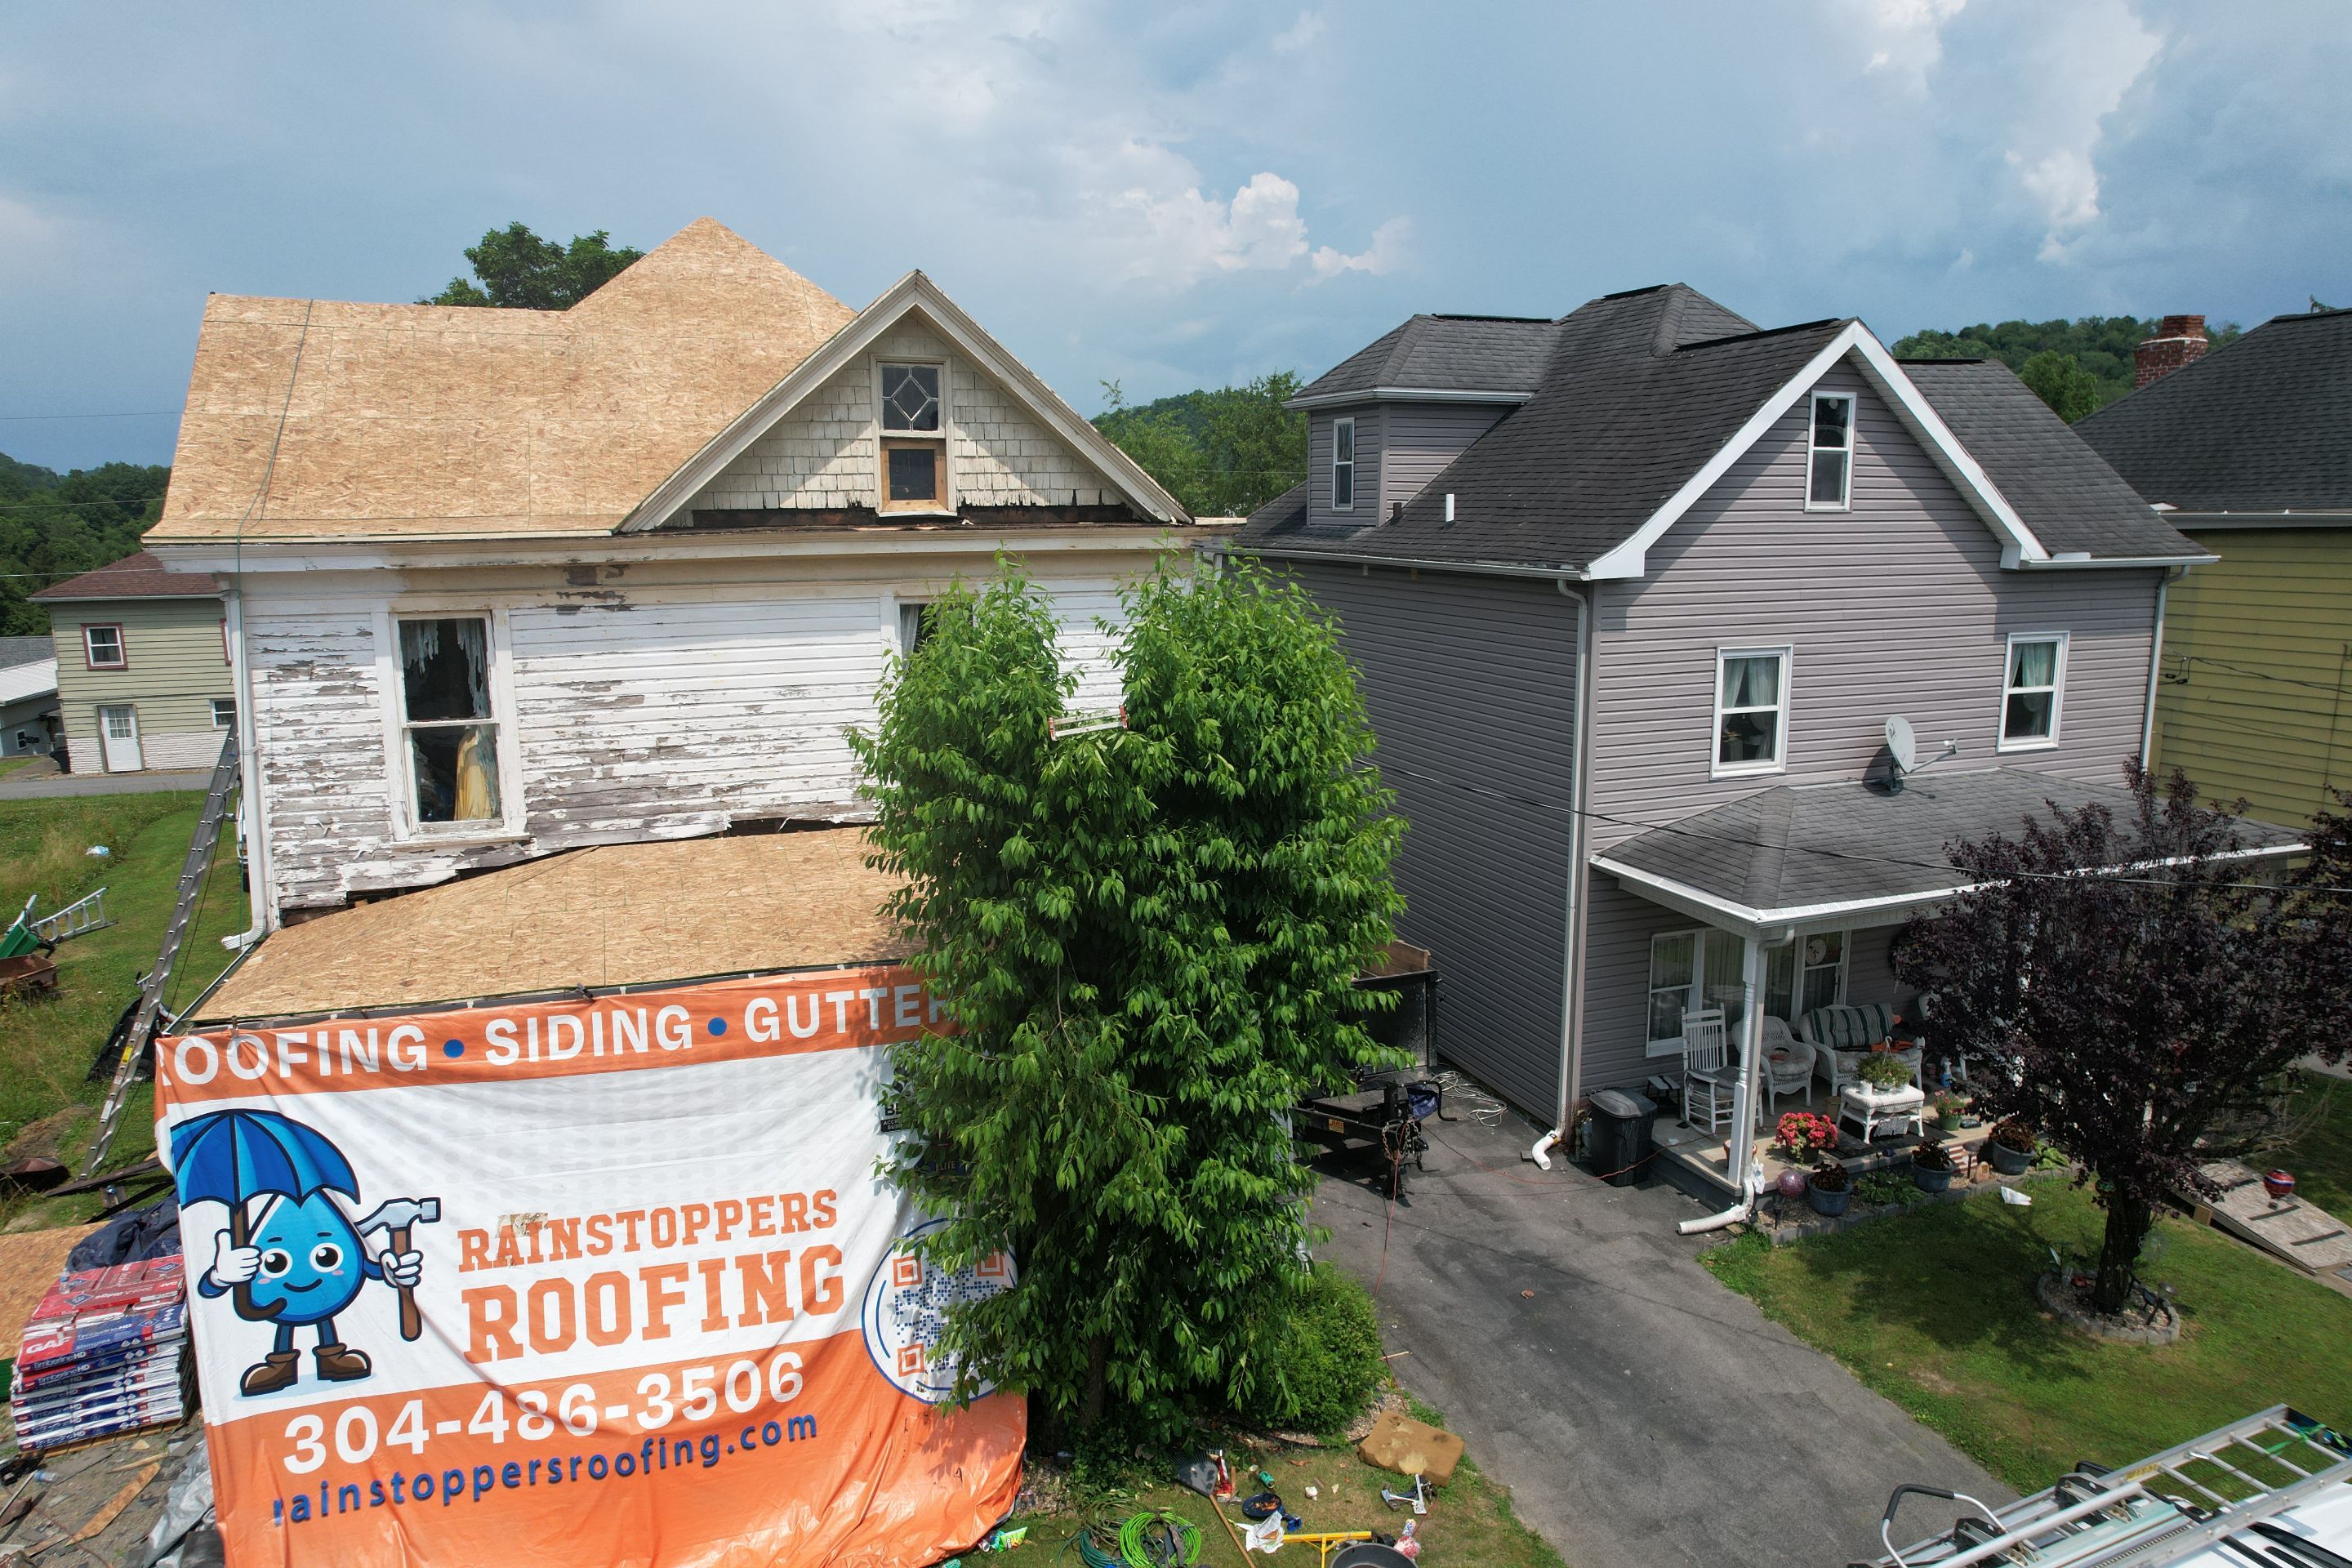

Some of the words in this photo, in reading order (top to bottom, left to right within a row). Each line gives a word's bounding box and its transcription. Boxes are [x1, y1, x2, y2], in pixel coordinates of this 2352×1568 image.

[485, 1004, 693, 1066] SIDING
[457, 1188, 837, 1273] RAINSTOPPERS
[25, 1336, 72, 1354] GAF
[461, 1244, 844, 1365] ROOFING
[283, 1352, 804, 1475] 304-486-3506
[273, 1414, 817, 1526] rainstoppersroofing.com
